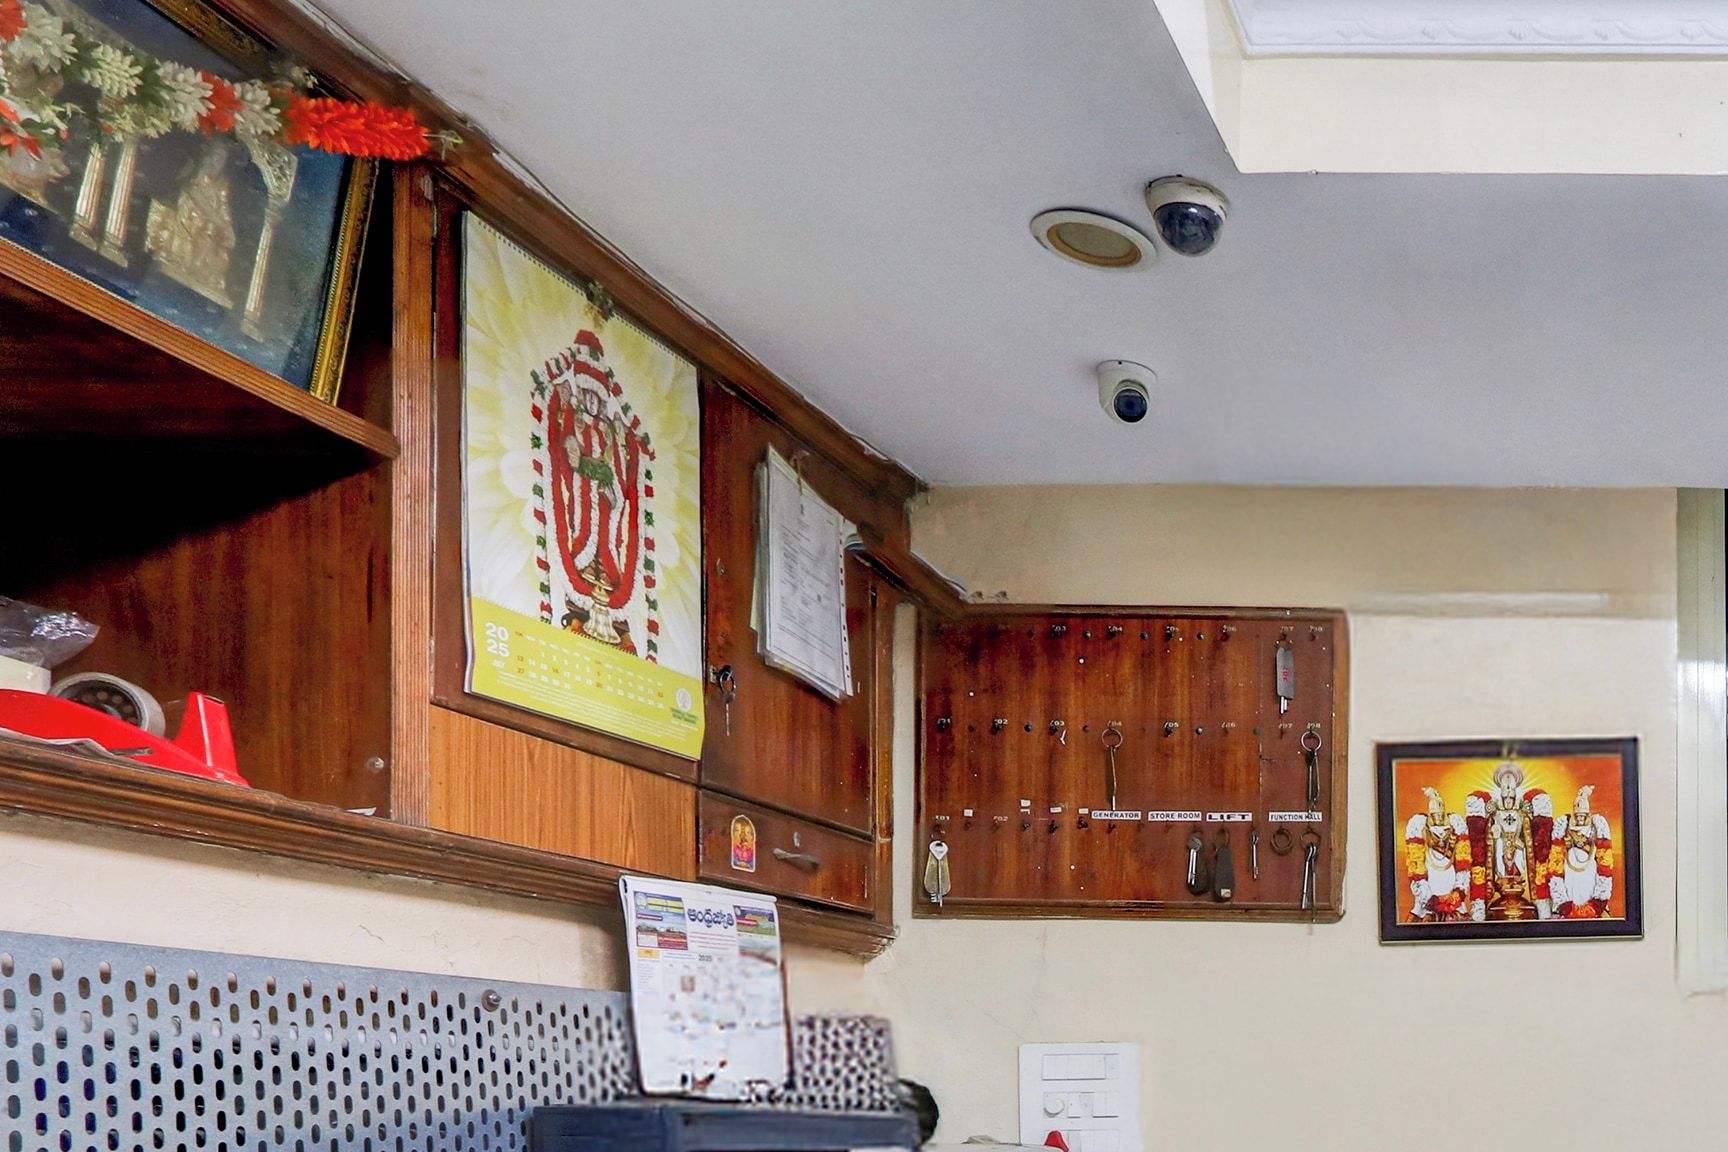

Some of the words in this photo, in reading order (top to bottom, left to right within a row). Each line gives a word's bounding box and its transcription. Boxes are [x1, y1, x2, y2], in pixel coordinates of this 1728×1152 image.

[485, 622, 509, 641] 20
[486, 639, 510, 657] 25
[1093, 811, 1140, 819] GENERATOR
[1150, 812, 1175, 820] STORE
[1207, 813, 1250, 821] LIFT
[1270, 813, 1304, 821] FUNCTION
